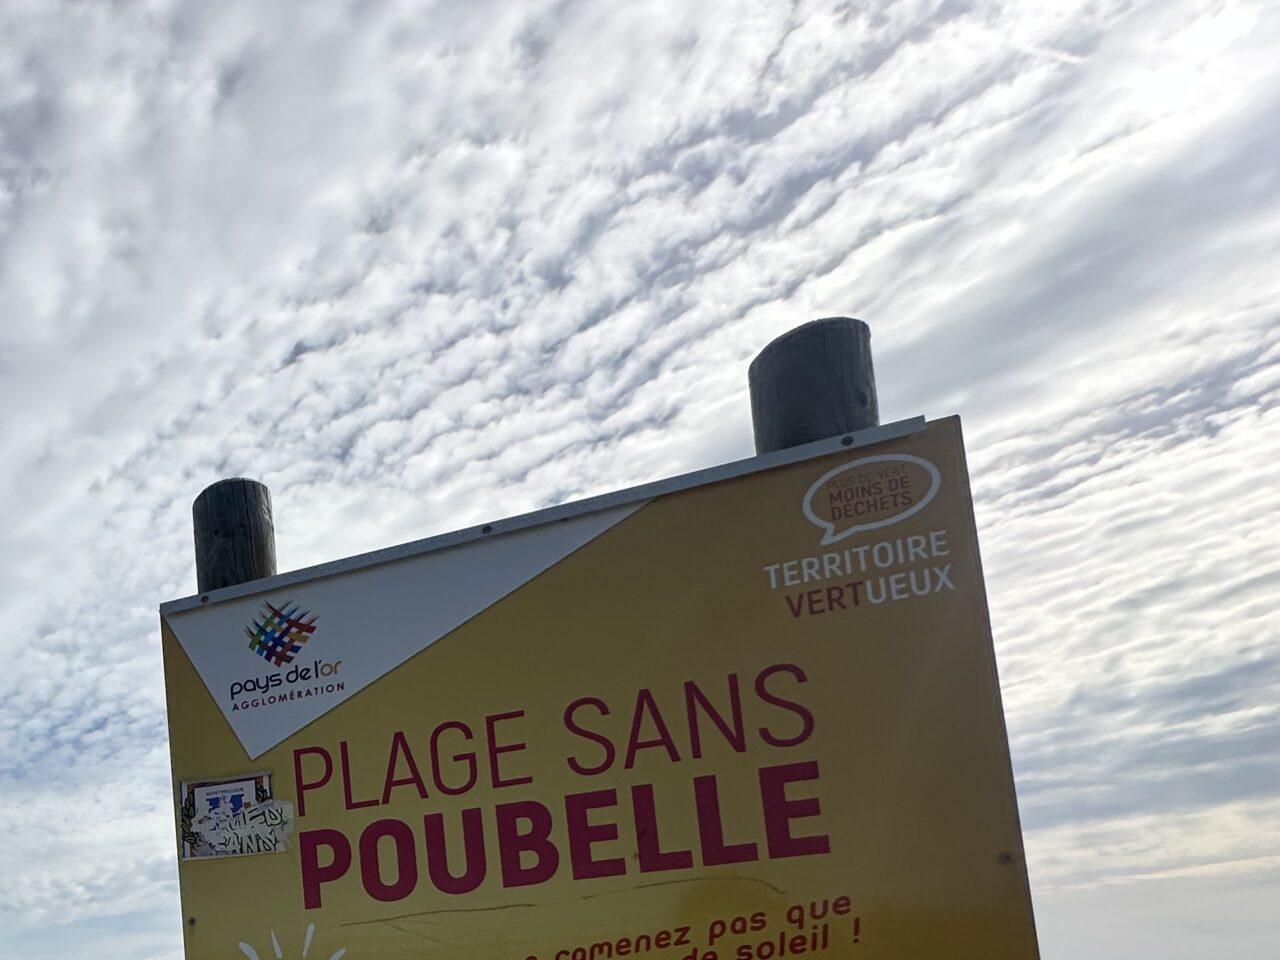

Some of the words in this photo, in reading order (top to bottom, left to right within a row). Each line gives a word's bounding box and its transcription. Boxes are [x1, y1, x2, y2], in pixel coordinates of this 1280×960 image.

[829, 481, 884, 506] MOINS
[888, 475, 910, 492] DE
[763, 530, 950, 590] TERRITOIRE
[785, 563, 956, 618] VERTUEUX
[230, 672, 283, 700] pays
[286, 665, 312, 683] de
[232, 681, 345, 711] AGGLOMÉRATION
[292, 710, 533, 817] PLAGE
[563, 663, 816, 776] SANS
[298, 760, 831, 910] POUBELLE
[708, 911, 767, 947] pas
[786, 894, 852, 930] que
[853, 917, 861, 944] !
